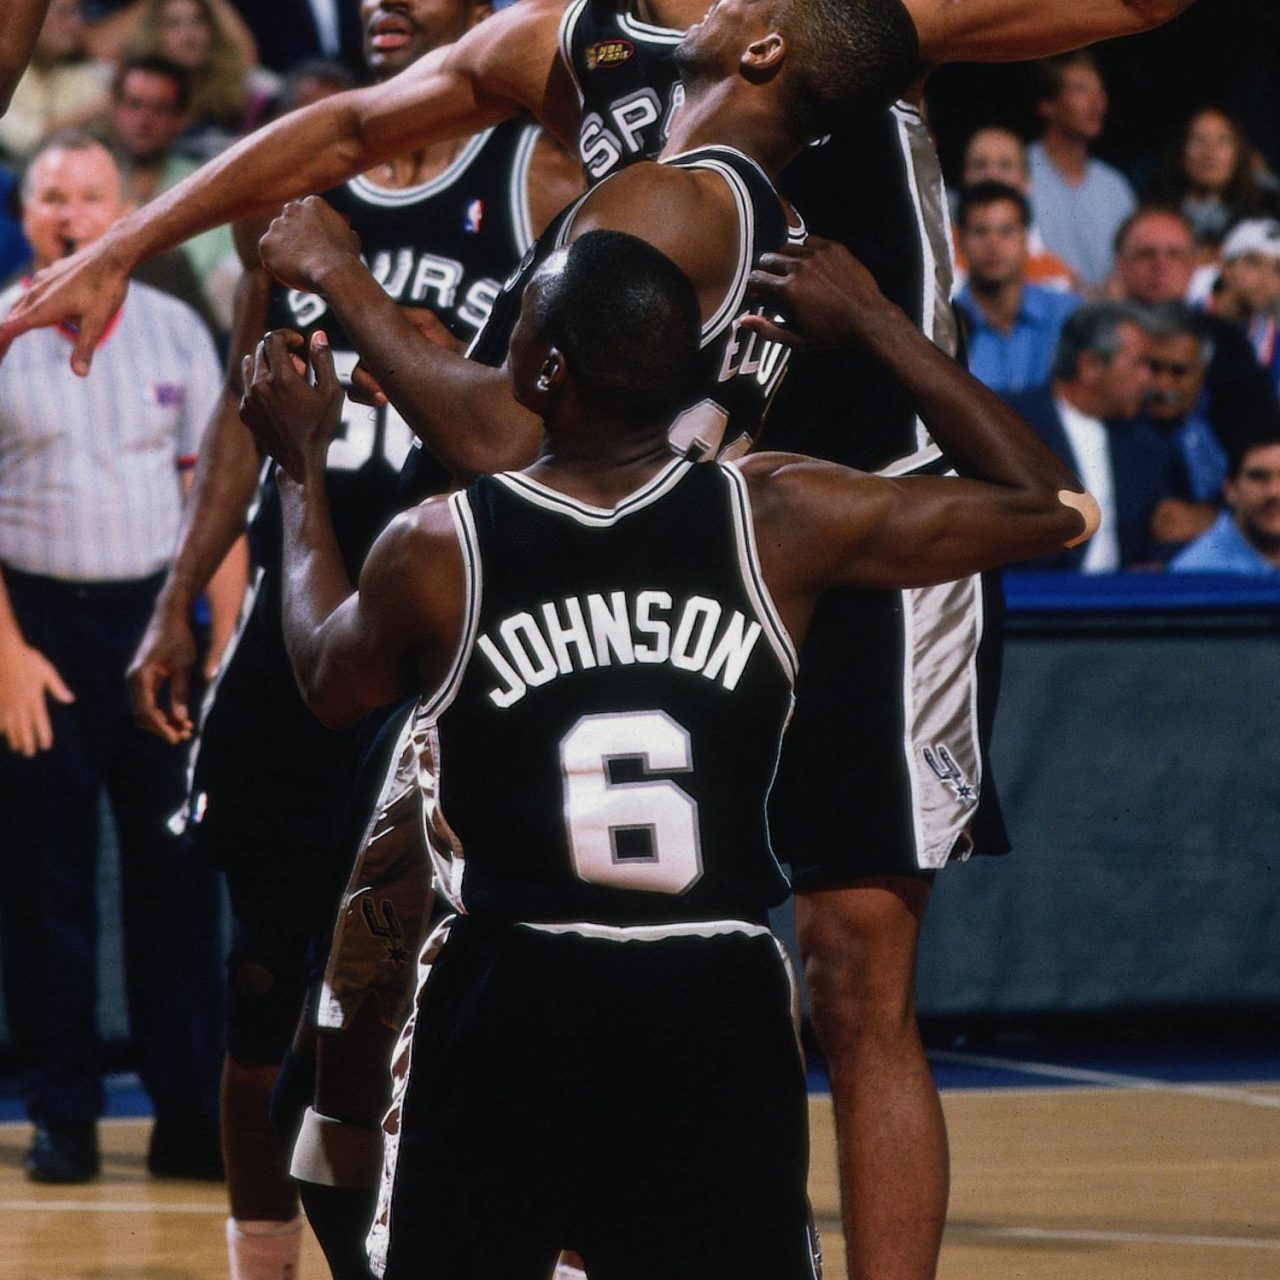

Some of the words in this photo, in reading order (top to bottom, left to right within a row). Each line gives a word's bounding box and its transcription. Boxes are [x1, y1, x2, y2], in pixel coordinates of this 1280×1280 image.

[579, 86, 686, 178] SP
[287, 247, 503, 330] SURS
[477, 590, 763, 709] JOHNSON
[558, 708, 705, 897] 6
